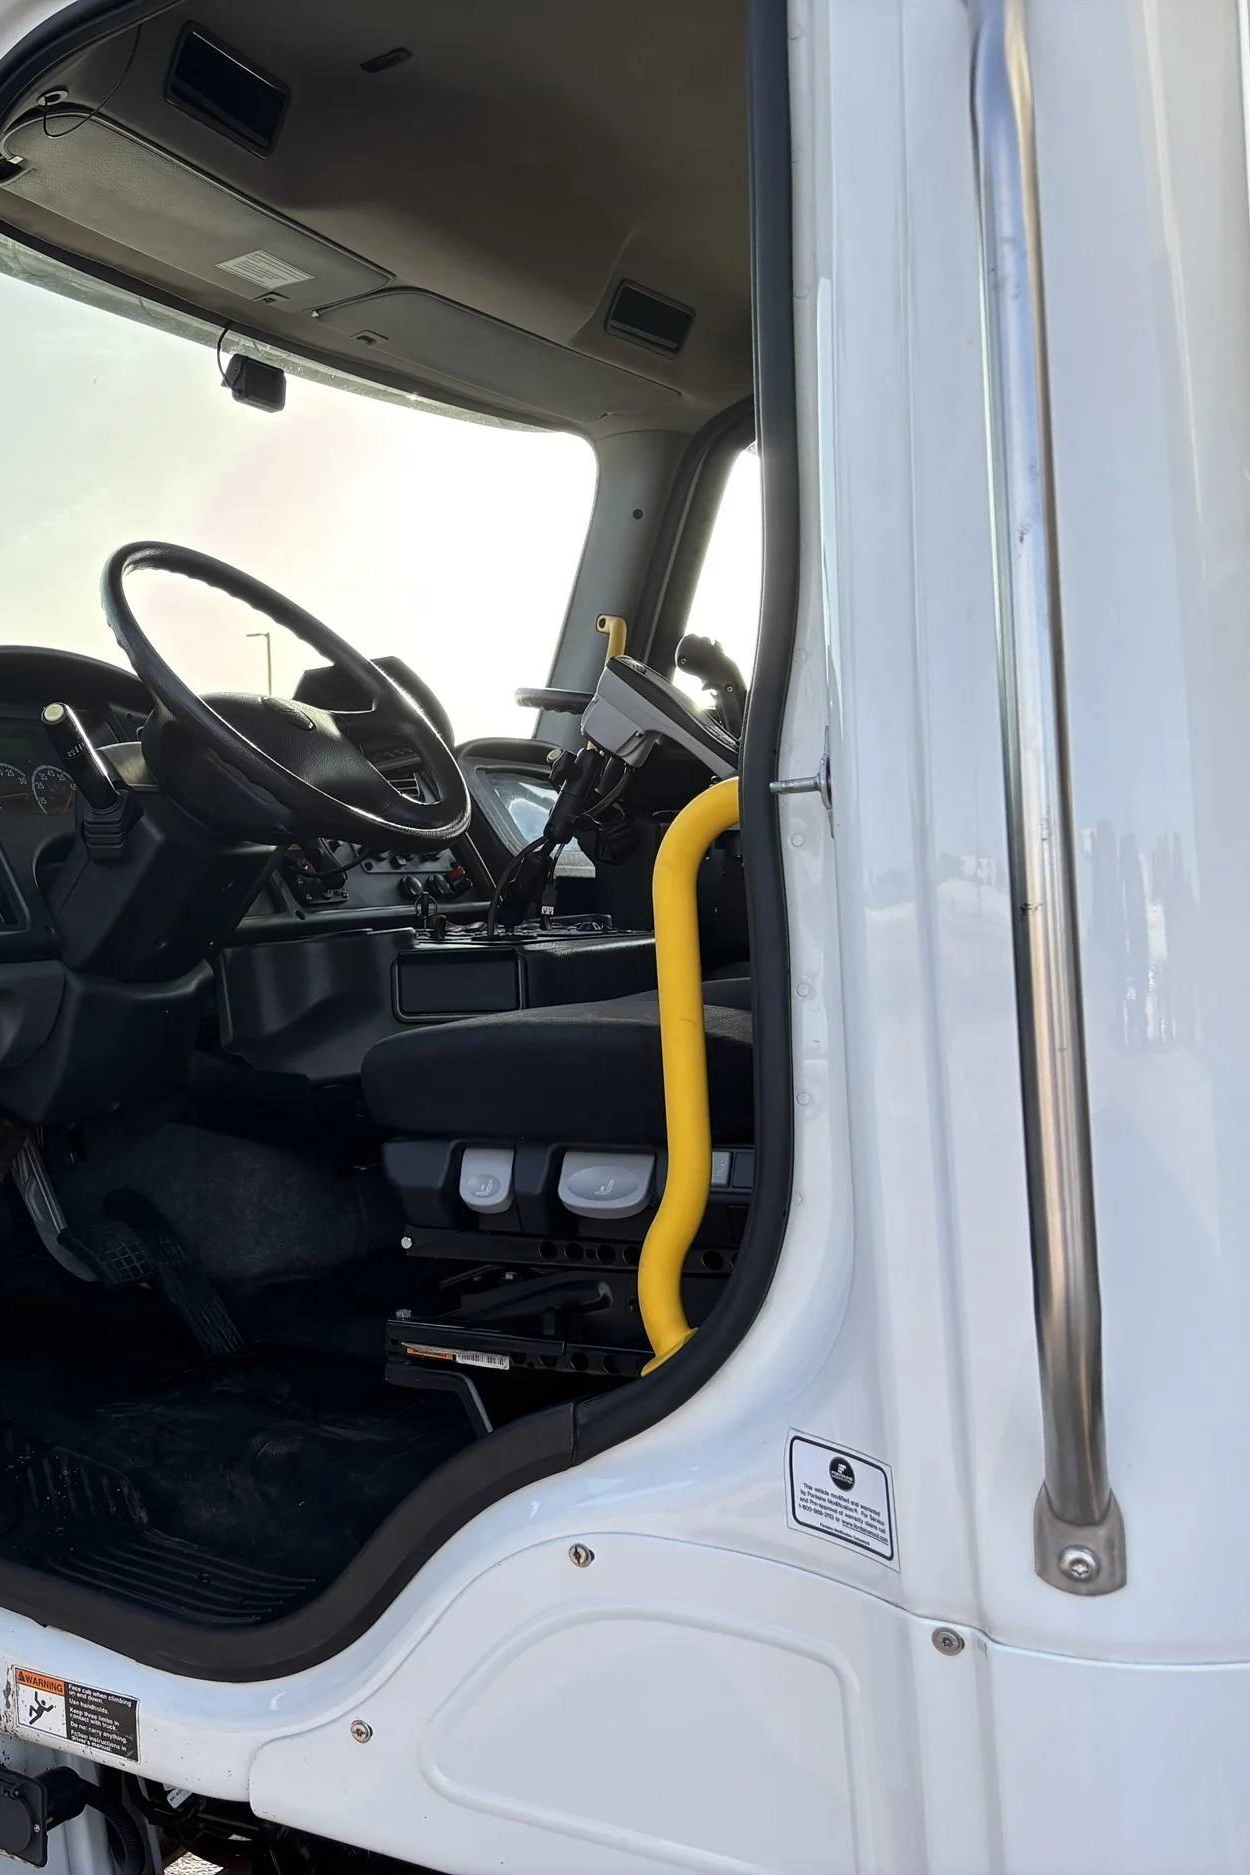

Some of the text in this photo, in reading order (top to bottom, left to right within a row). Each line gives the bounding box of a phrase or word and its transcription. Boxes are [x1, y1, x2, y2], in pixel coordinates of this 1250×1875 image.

[5, 769, 14, 777] 25
[18, 776, 27, 785] 30
[803, 1483, 813, 1491] This
[815, 1487, 829, 1496] vehicle
[851, 1499, 859, 1507] and
[25, 1675, 63, 1692] WARNING
[68, 1684, 81, 1692] Face
[108, 1696, 132, 1707] climbing
[69, 1698, 79, 1706] Use
[91, 1718, 101, 1726] with
